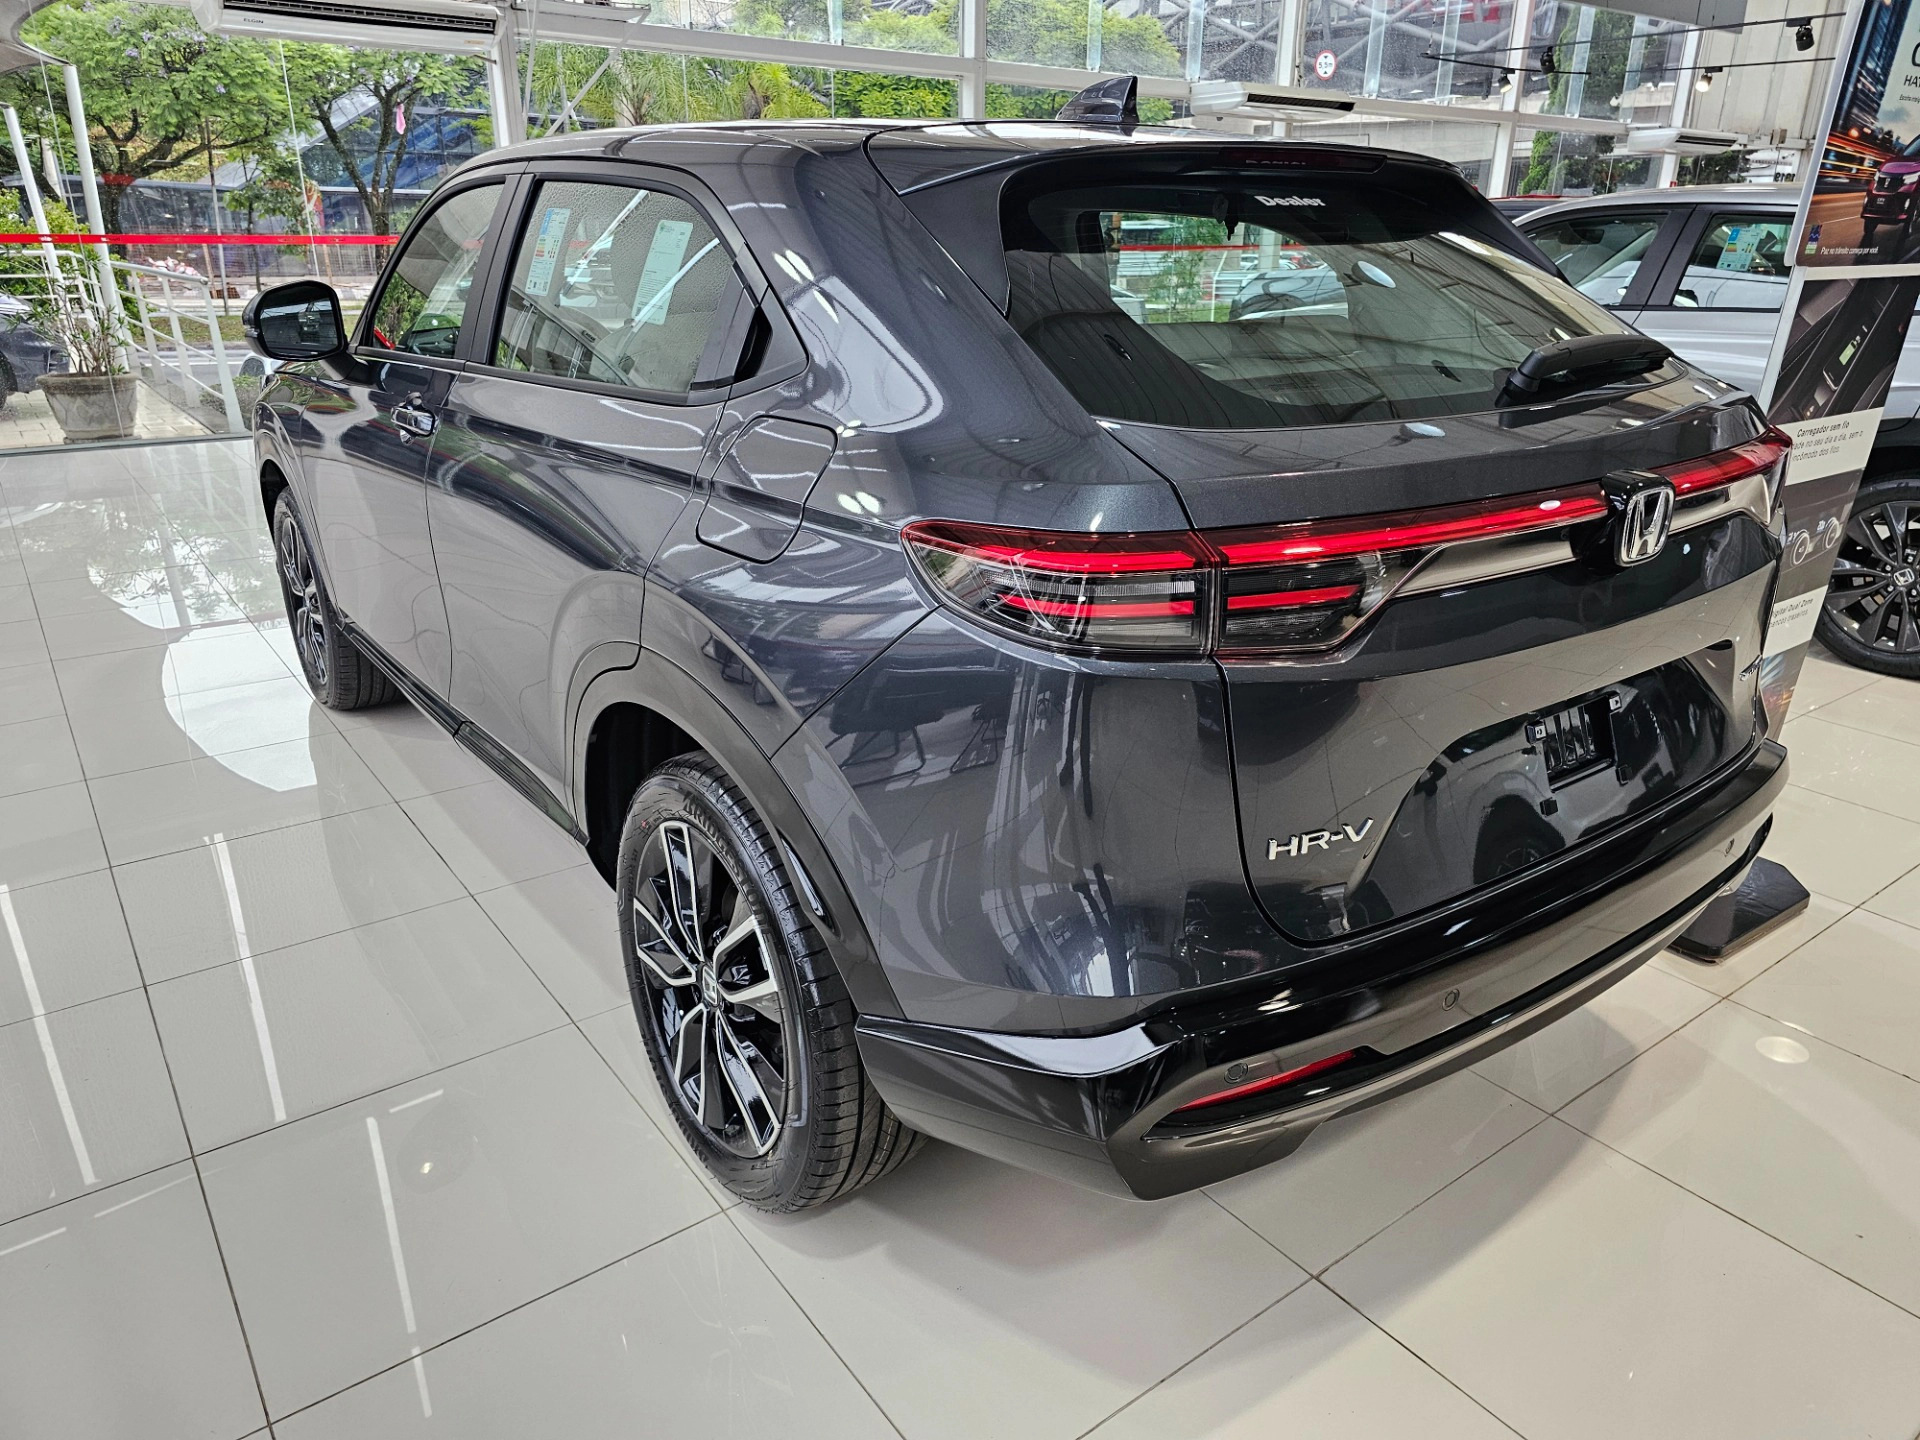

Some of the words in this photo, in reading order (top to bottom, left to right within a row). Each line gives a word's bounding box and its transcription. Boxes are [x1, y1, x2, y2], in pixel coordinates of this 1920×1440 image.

[1253, 195, 1326, 207] Dealer
[1797, 424, 1830, 438] Carregador
[1830, 423, 1841, 431] sem
[1842, 420, 1850, 429] fio
[1267, 816, 1374, 860] HR-V
